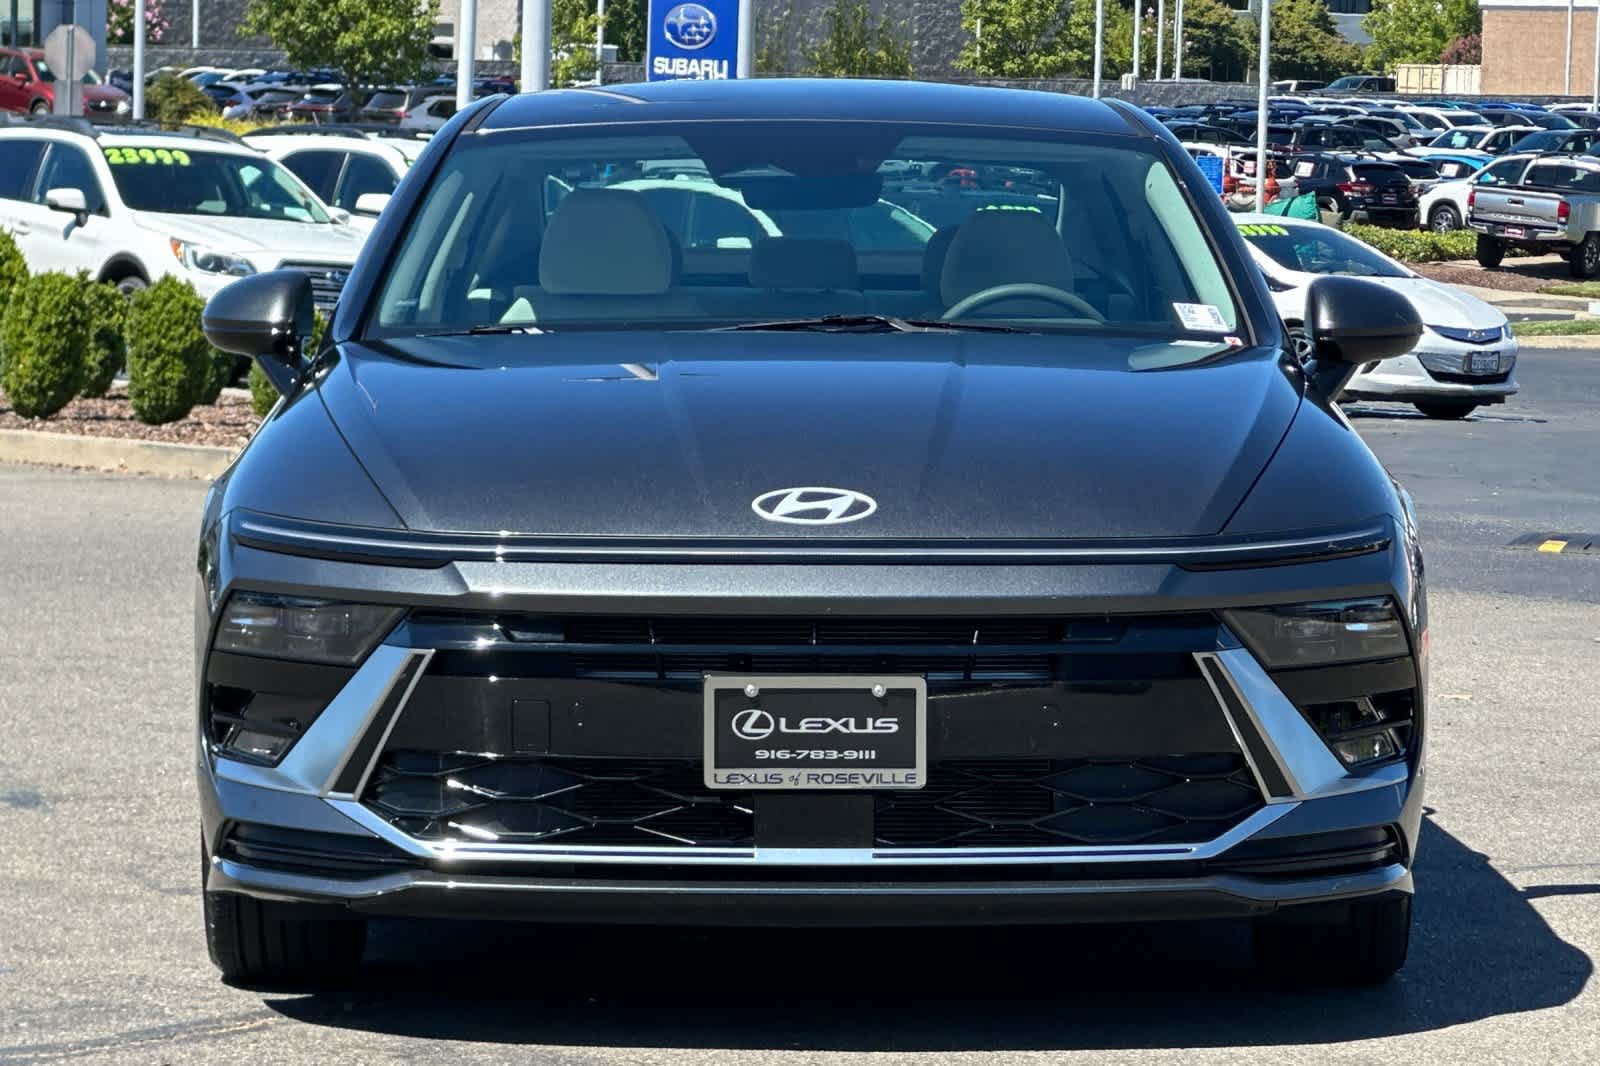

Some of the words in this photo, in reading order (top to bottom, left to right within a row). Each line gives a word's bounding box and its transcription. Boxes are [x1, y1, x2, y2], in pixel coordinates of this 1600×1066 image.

[653, 56, 728, 77] SUBARU
[104, 147, 190, 166] 23999
[779, 717, 899, 734] LEXUS
[755, 749, 876, 760] 916-783-9111
[713, 773, 783, 785] LEXUS
[788, 771, 802, 786] of
[806, 773, 917, 785] ROSEVILLE
